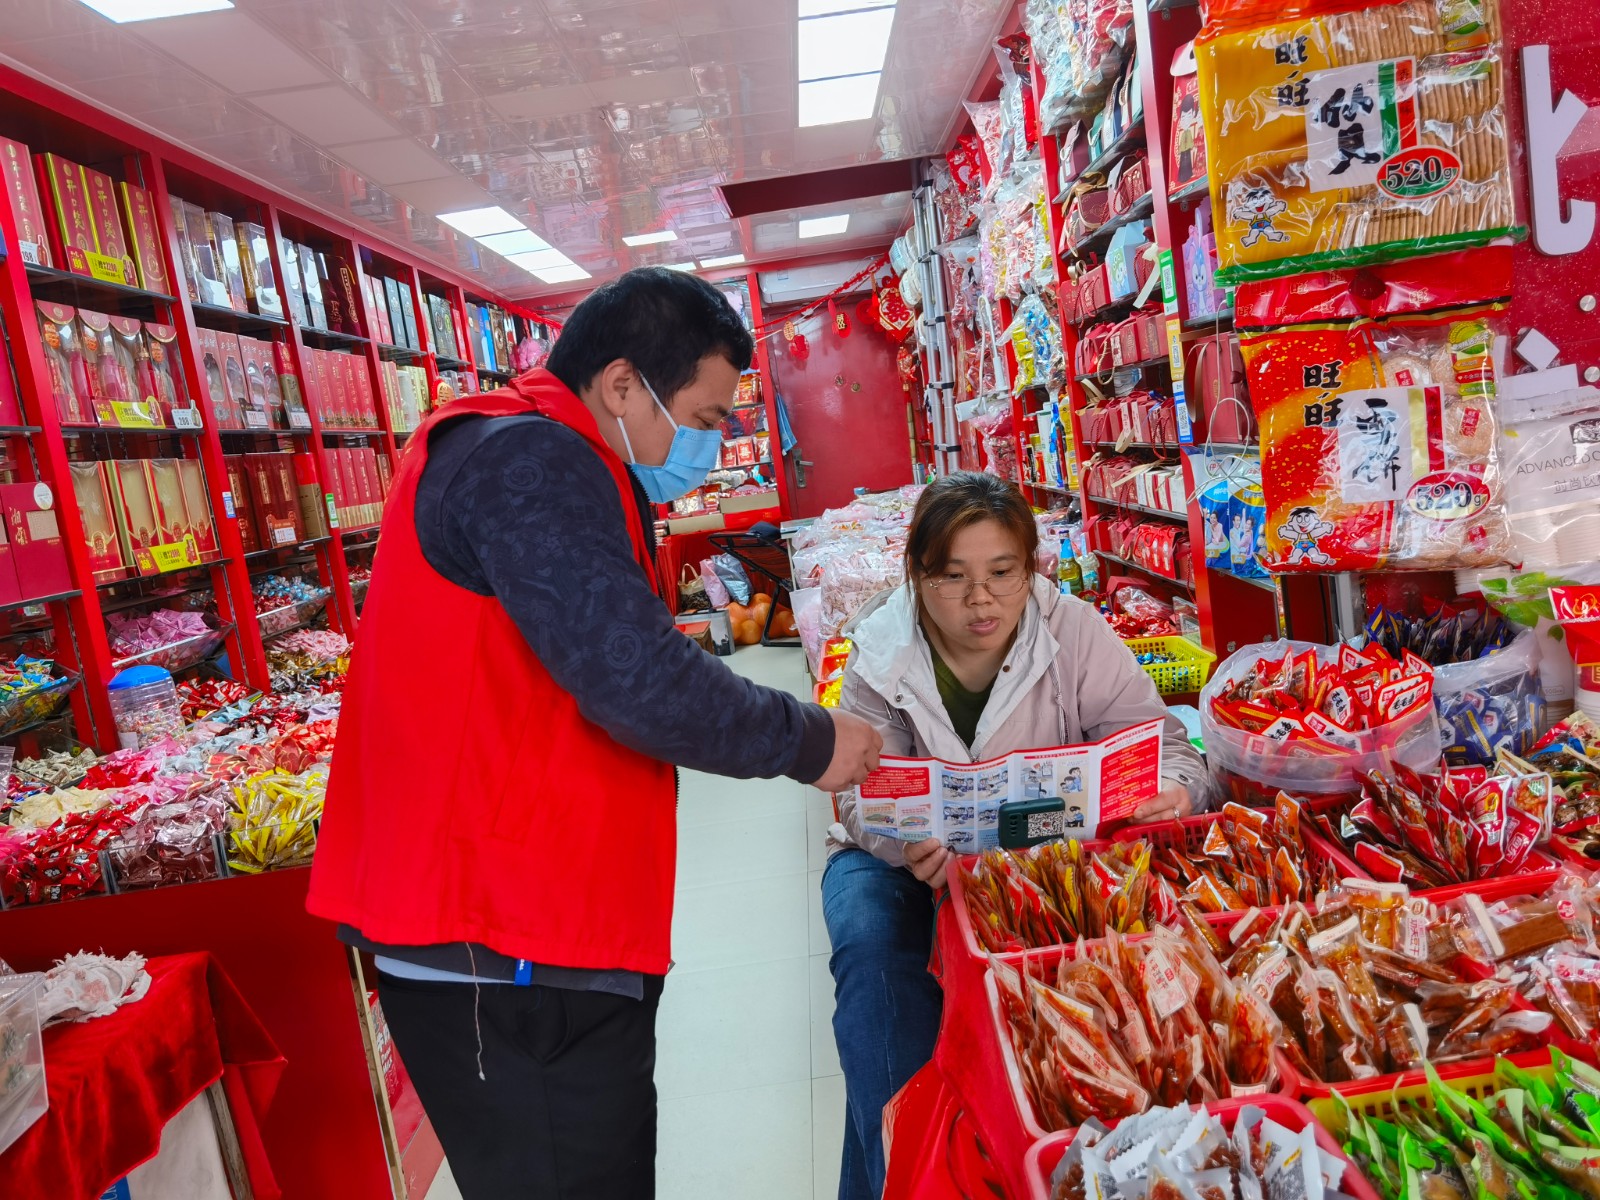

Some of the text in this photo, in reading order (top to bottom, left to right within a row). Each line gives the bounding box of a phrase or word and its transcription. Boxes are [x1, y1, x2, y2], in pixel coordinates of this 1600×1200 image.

[1387, 157, 1452, 190] 520g
[1303, 361, 1343, 427] 旺旺
[1416, 482, 1482, 511] 520g
